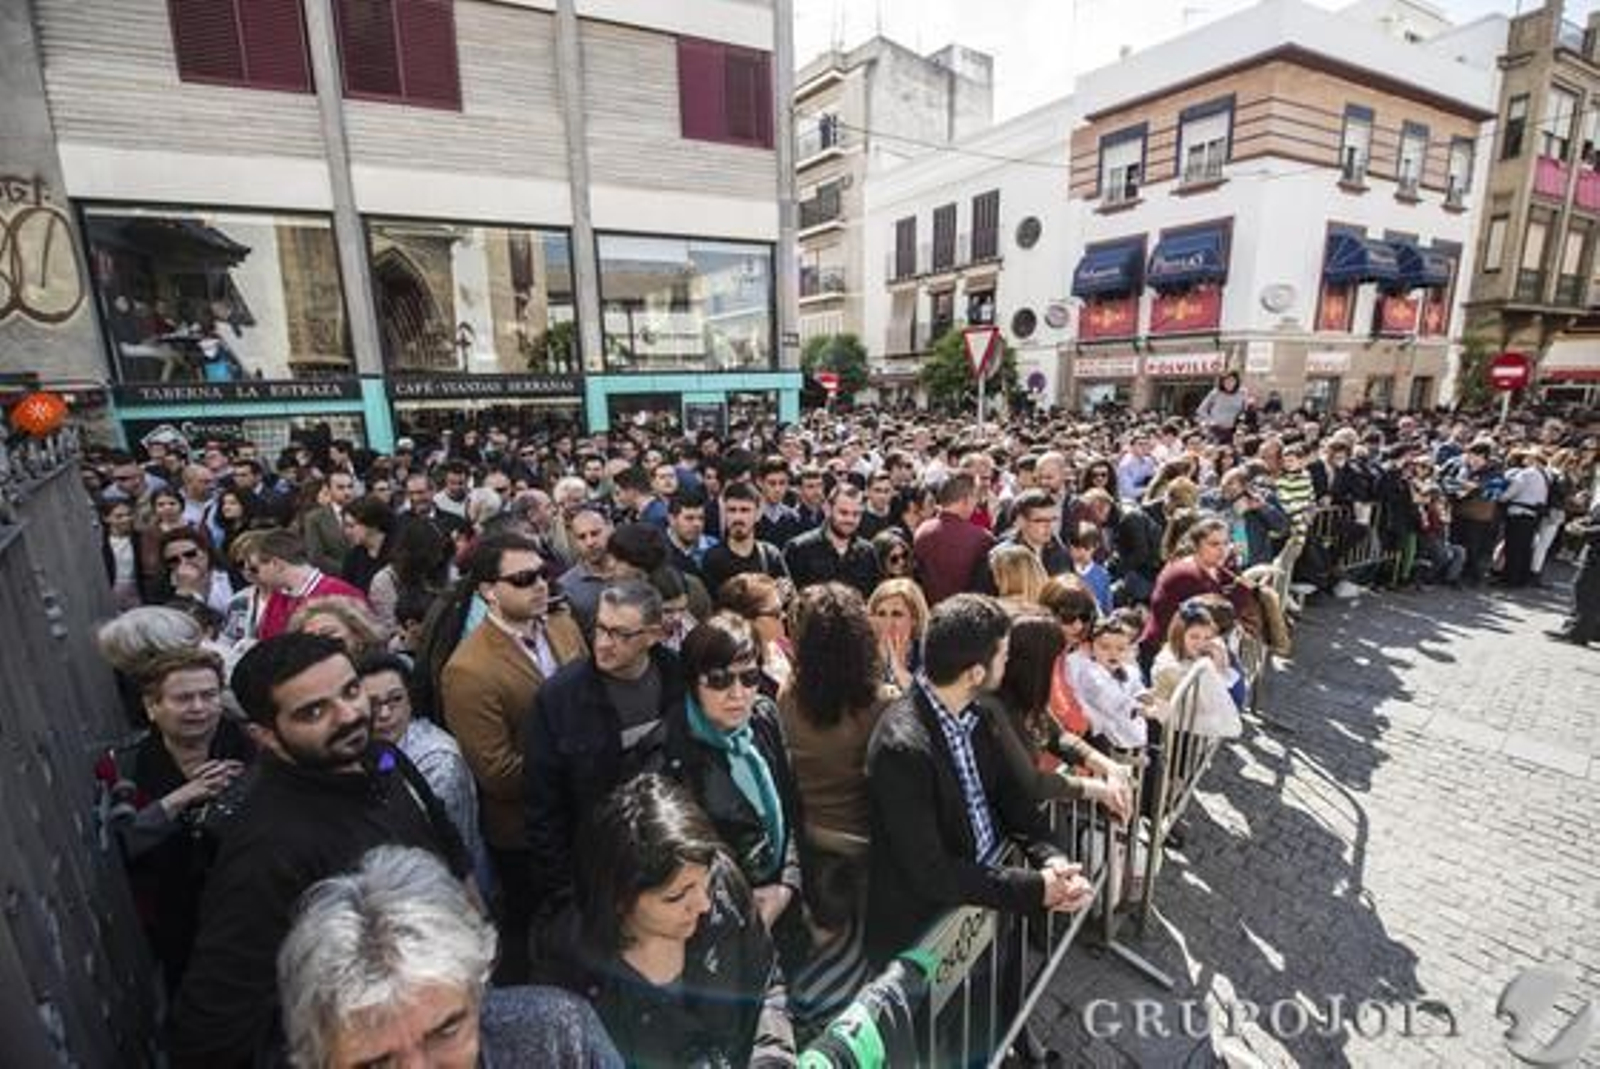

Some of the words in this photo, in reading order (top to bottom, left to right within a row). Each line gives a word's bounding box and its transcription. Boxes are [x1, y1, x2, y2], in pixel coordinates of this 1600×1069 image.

[138, 386, 223, 401] TABERNA
[235, 385, 260, 398] LA
[269, 383, 342, 397] ESTRAZA
[507, 380, 574, 393] SERRANAS
